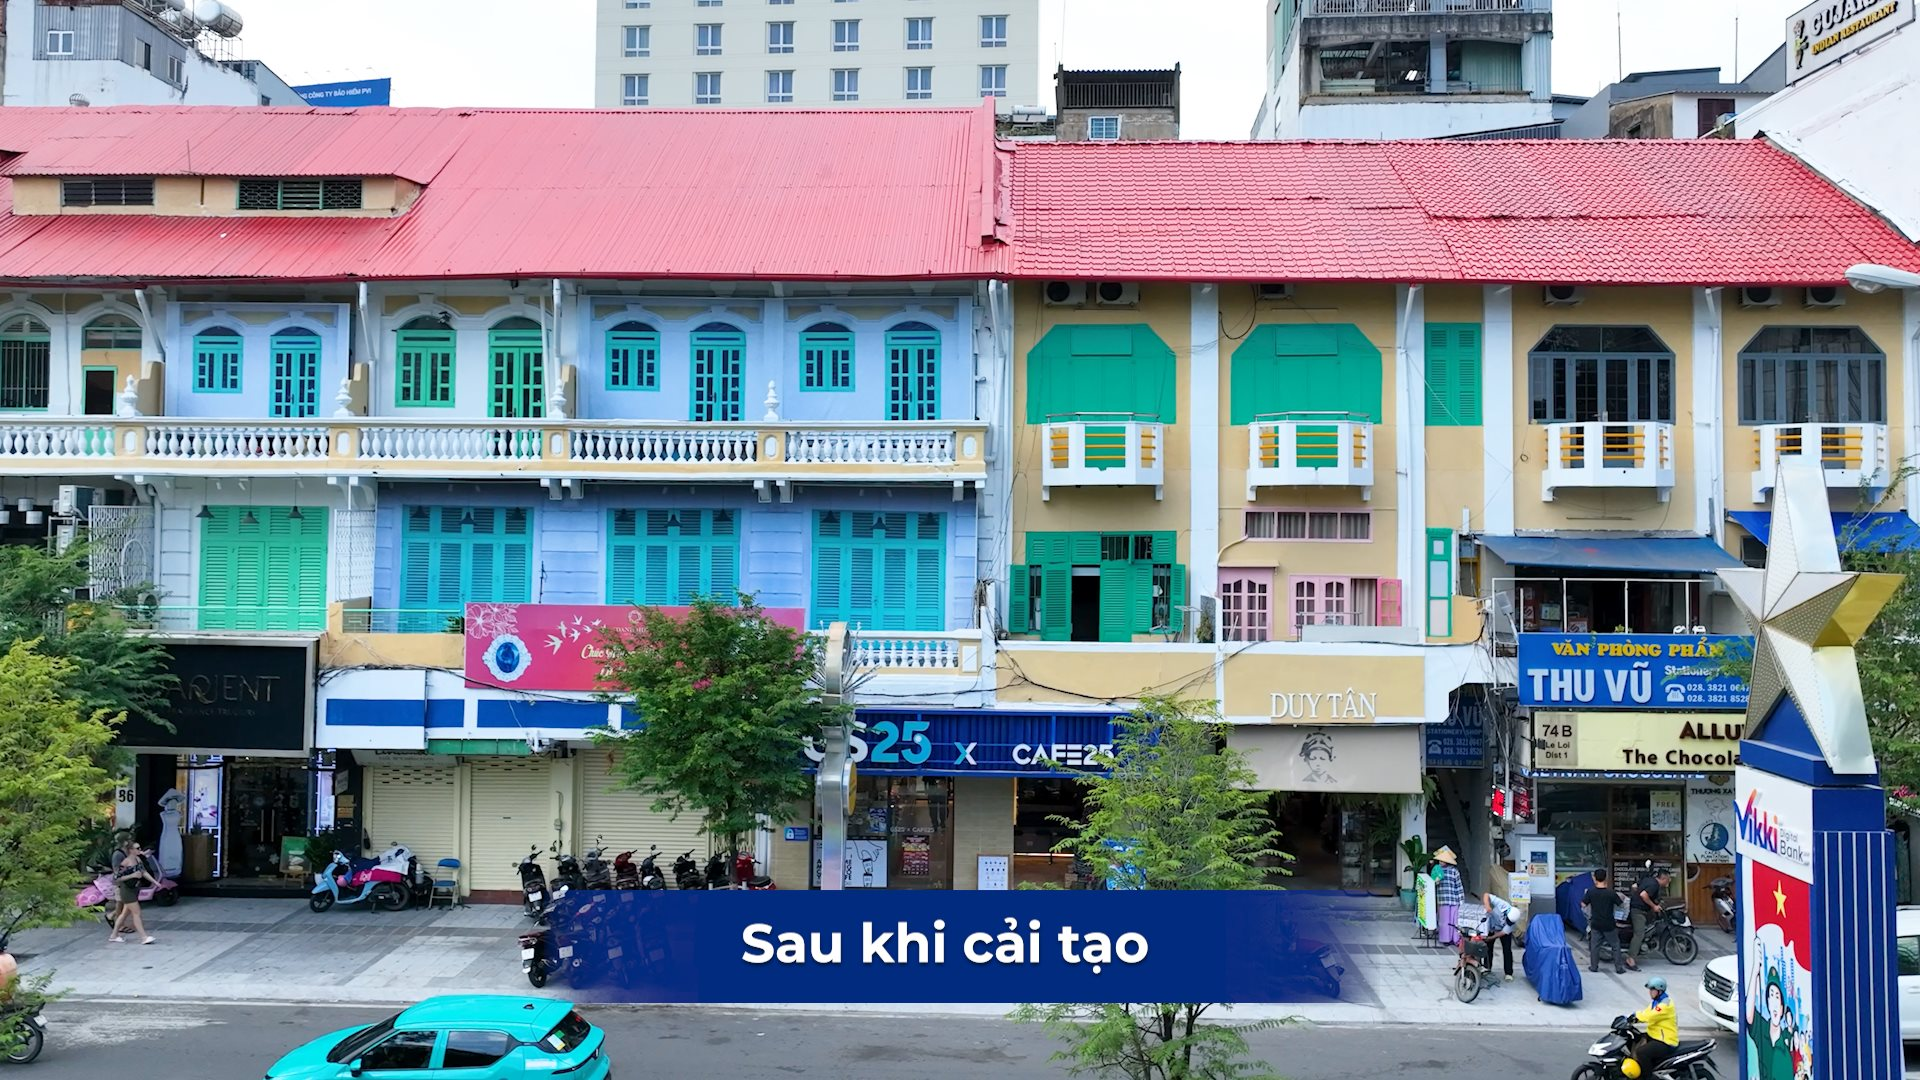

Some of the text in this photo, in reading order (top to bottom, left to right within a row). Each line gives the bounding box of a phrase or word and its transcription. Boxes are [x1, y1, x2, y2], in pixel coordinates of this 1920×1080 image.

[1811, 1, 1899, 56] INDIAN RESTAURANT
[1551, 639, 1591, 657] VĂN
[1597, 639, 1662, 657] PHÒNG
[1527, 661, 1651, 703] THU VŨ
[1687, 683, 1705, 692] 028.
[1707, 683, 1727, 692] 3821
[1270, 687, 1377, 719] DUY TÂN
[1687, 694, 1705, 703] 028.
[1707, 694, 1727, 703] 3821
[1542, 724, 1572, 737] 74 B
[1545, 741, 1570, 749] Le Loi
[1545, 751, 1568, 759] Dist 1
[1622, 749, 1658, 765] The
[1733, 789, 1778, 854] Vikki
[1780, 839, 1804, 862] Bank
